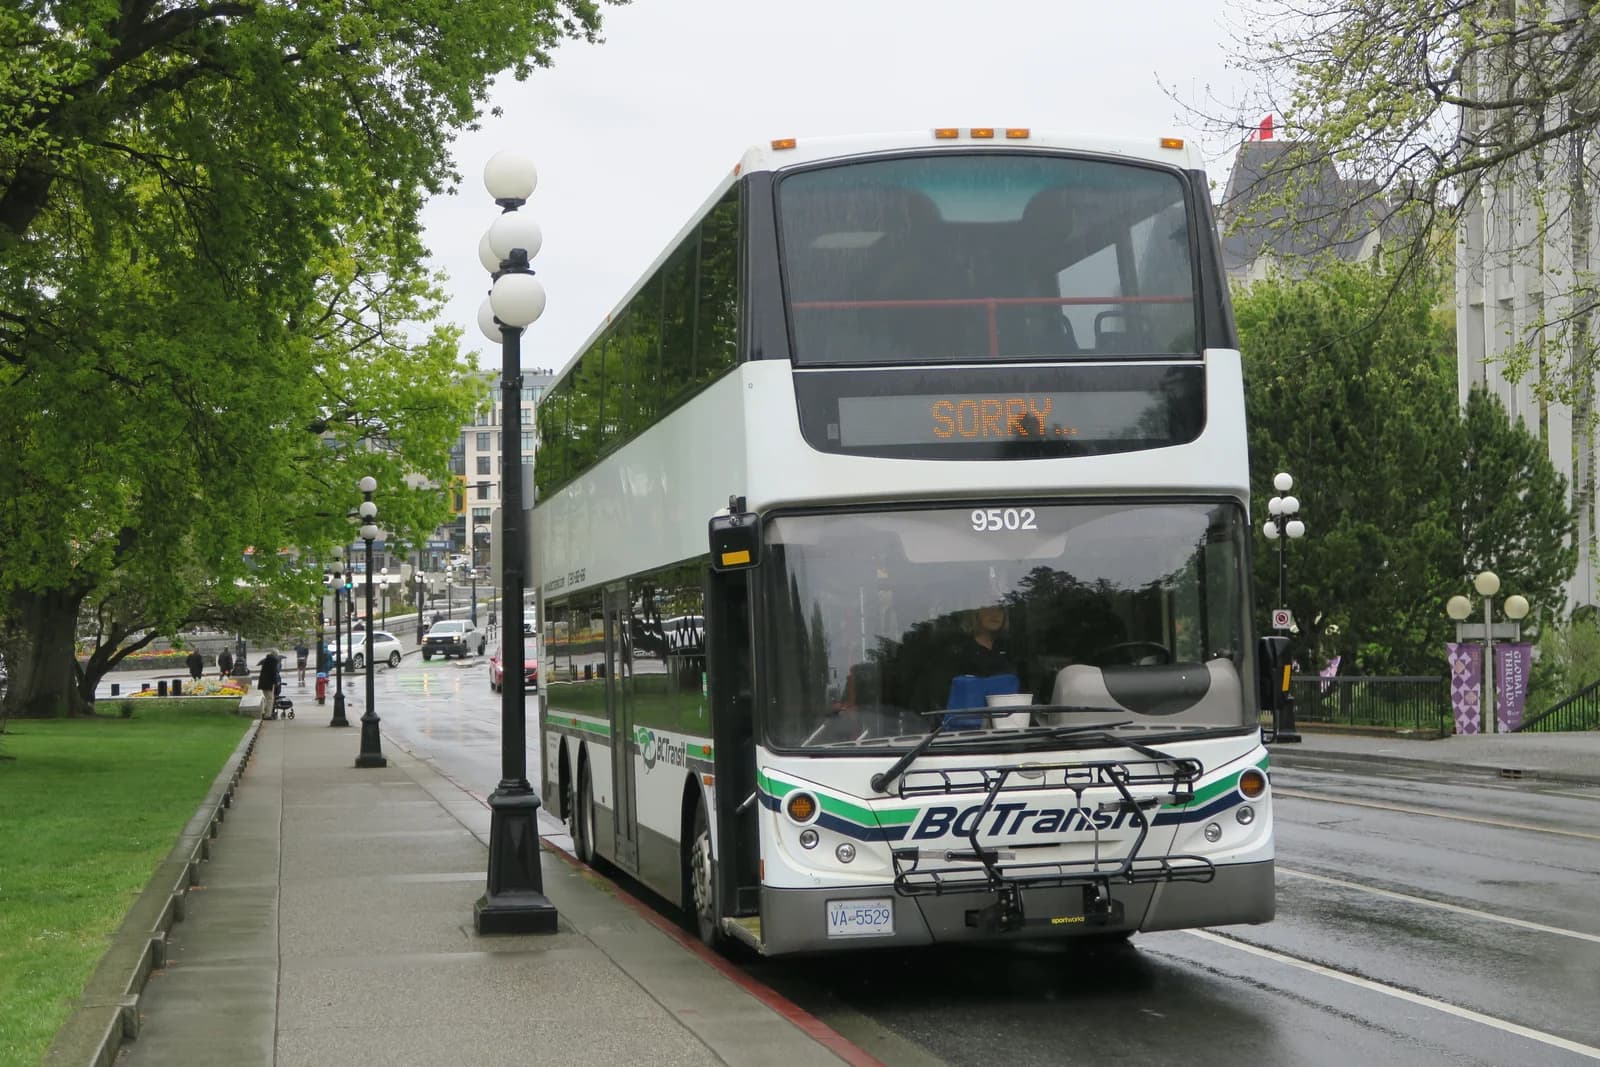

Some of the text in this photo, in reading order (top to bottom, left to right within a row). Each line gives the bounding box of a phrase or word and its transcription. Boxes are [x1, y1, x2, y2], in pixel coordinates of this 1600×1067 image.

[971, 507, 1038, 532] 9502
[1504, 650, 1515, 707] THREADS
[1513, 650, 1523, 698] GLOBAL
[855, 908, 890, 926] 5529
